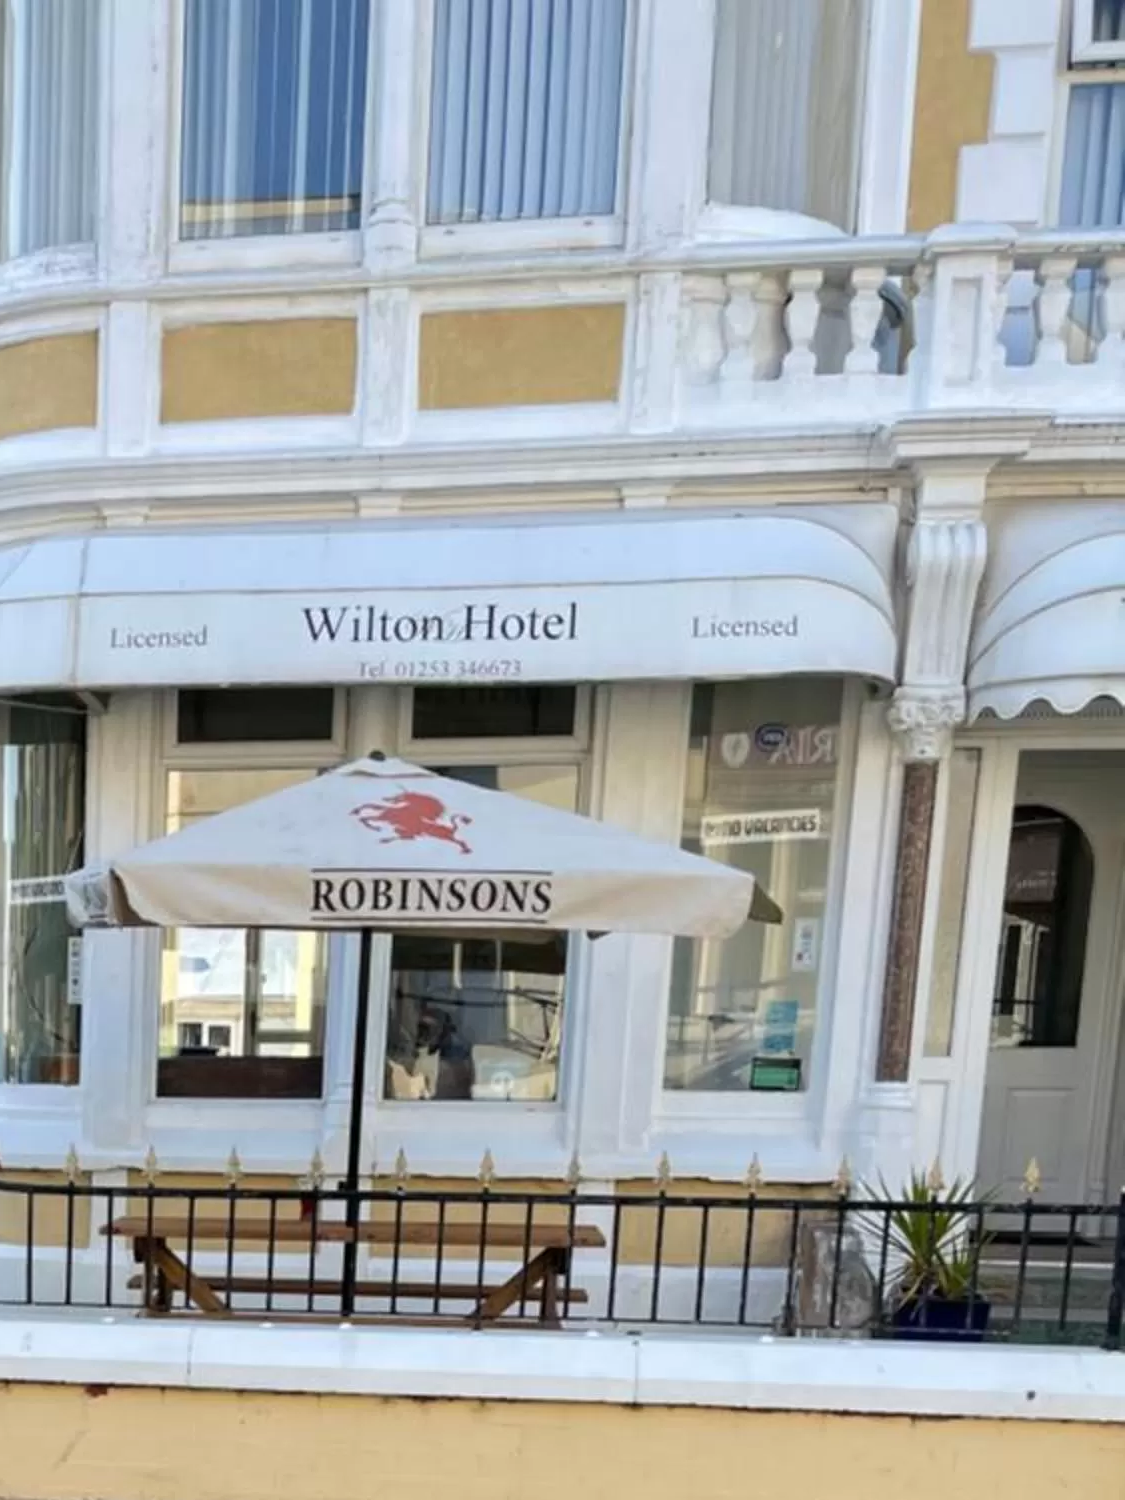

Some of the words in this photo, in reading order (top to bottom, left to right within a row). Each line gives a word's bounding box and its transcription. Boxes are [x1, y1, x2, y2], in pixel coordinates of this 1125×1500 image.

[303, 604, 447, 642] Wilton
[462, 601, 579, 641] Hotel
[692, 613, 798, 638] Licensed
[110, 623, 208, 649] Licensed
[394, 660, 450, 677] 01253
[458, 658, 522, 677] 346673
[311, 877, 553, 914] ROBINSONS
